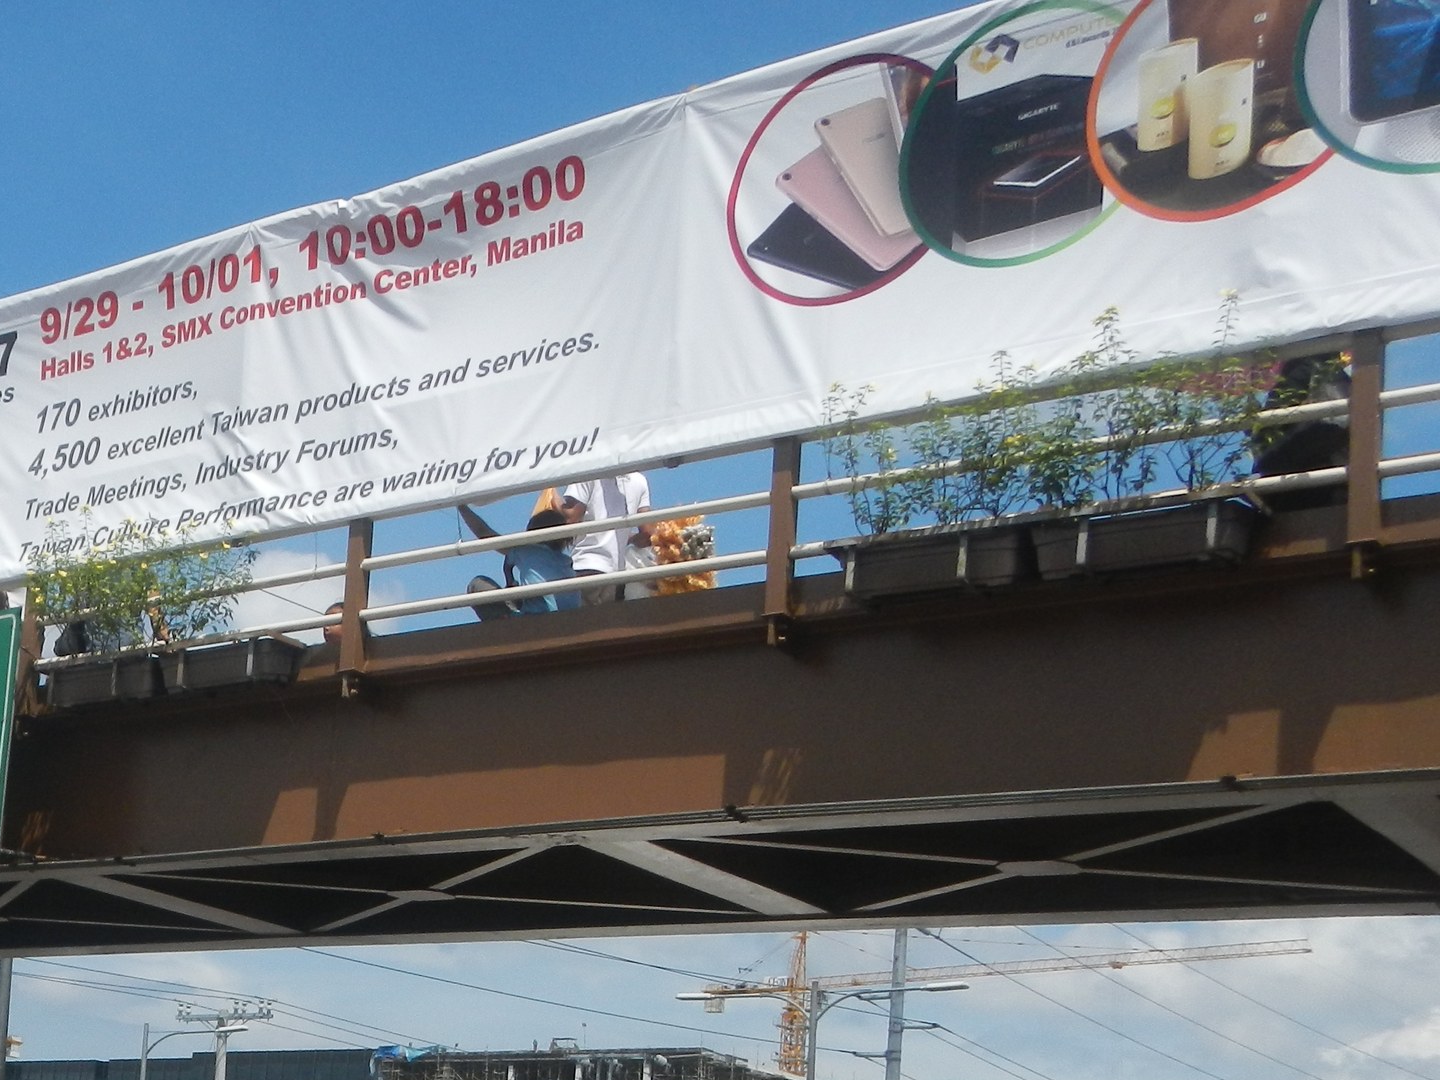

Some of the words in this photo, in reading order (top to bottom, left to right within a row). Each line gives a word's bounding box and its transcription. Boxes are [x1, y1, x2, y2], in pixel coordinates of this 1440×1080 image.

[39, 290, 119, 345] 9/29
[158, 244, 280, 311] 10/01,
[299, 155, 587, 271] 10:00-18:00
[40, 352, 95, 381] Halls
[102, 331, 154, 368] 1&2,
[161, 310, 213, 349] SMX
[220, 280, 367, 331] Convention
[374, 252, 478, 294] Center,
[487, 217, 585, 266] Manila
[25, 494, 80, 522] Trade
[85, 472, 187, 512] Meetings,
[195, 446, 290, 487] Industry
[295, 425, 400, 467] Forums,
[27, 437, 101, 482] 4,500
[107, 420, 206, 461] excellent
[210, 399, 289, 438] Taiwan
[295, 375, 412, 425] products
[418, 358, 473, 393] and
[475, 331, 601, 380] services.
[36, 400, 81, 434] 170
[88, 378, 199, 424] exhibitors,
[18, 534, 87, 563] Taiwan
[91, 517, 172, 547] Culture
[176, 488, 328, 530] Performance
[334, 478, 375, 503] are
[381, 453, 478, 495] waiting
[483, 440, 528, 473] for
[530, 427, 601, 468] you!
